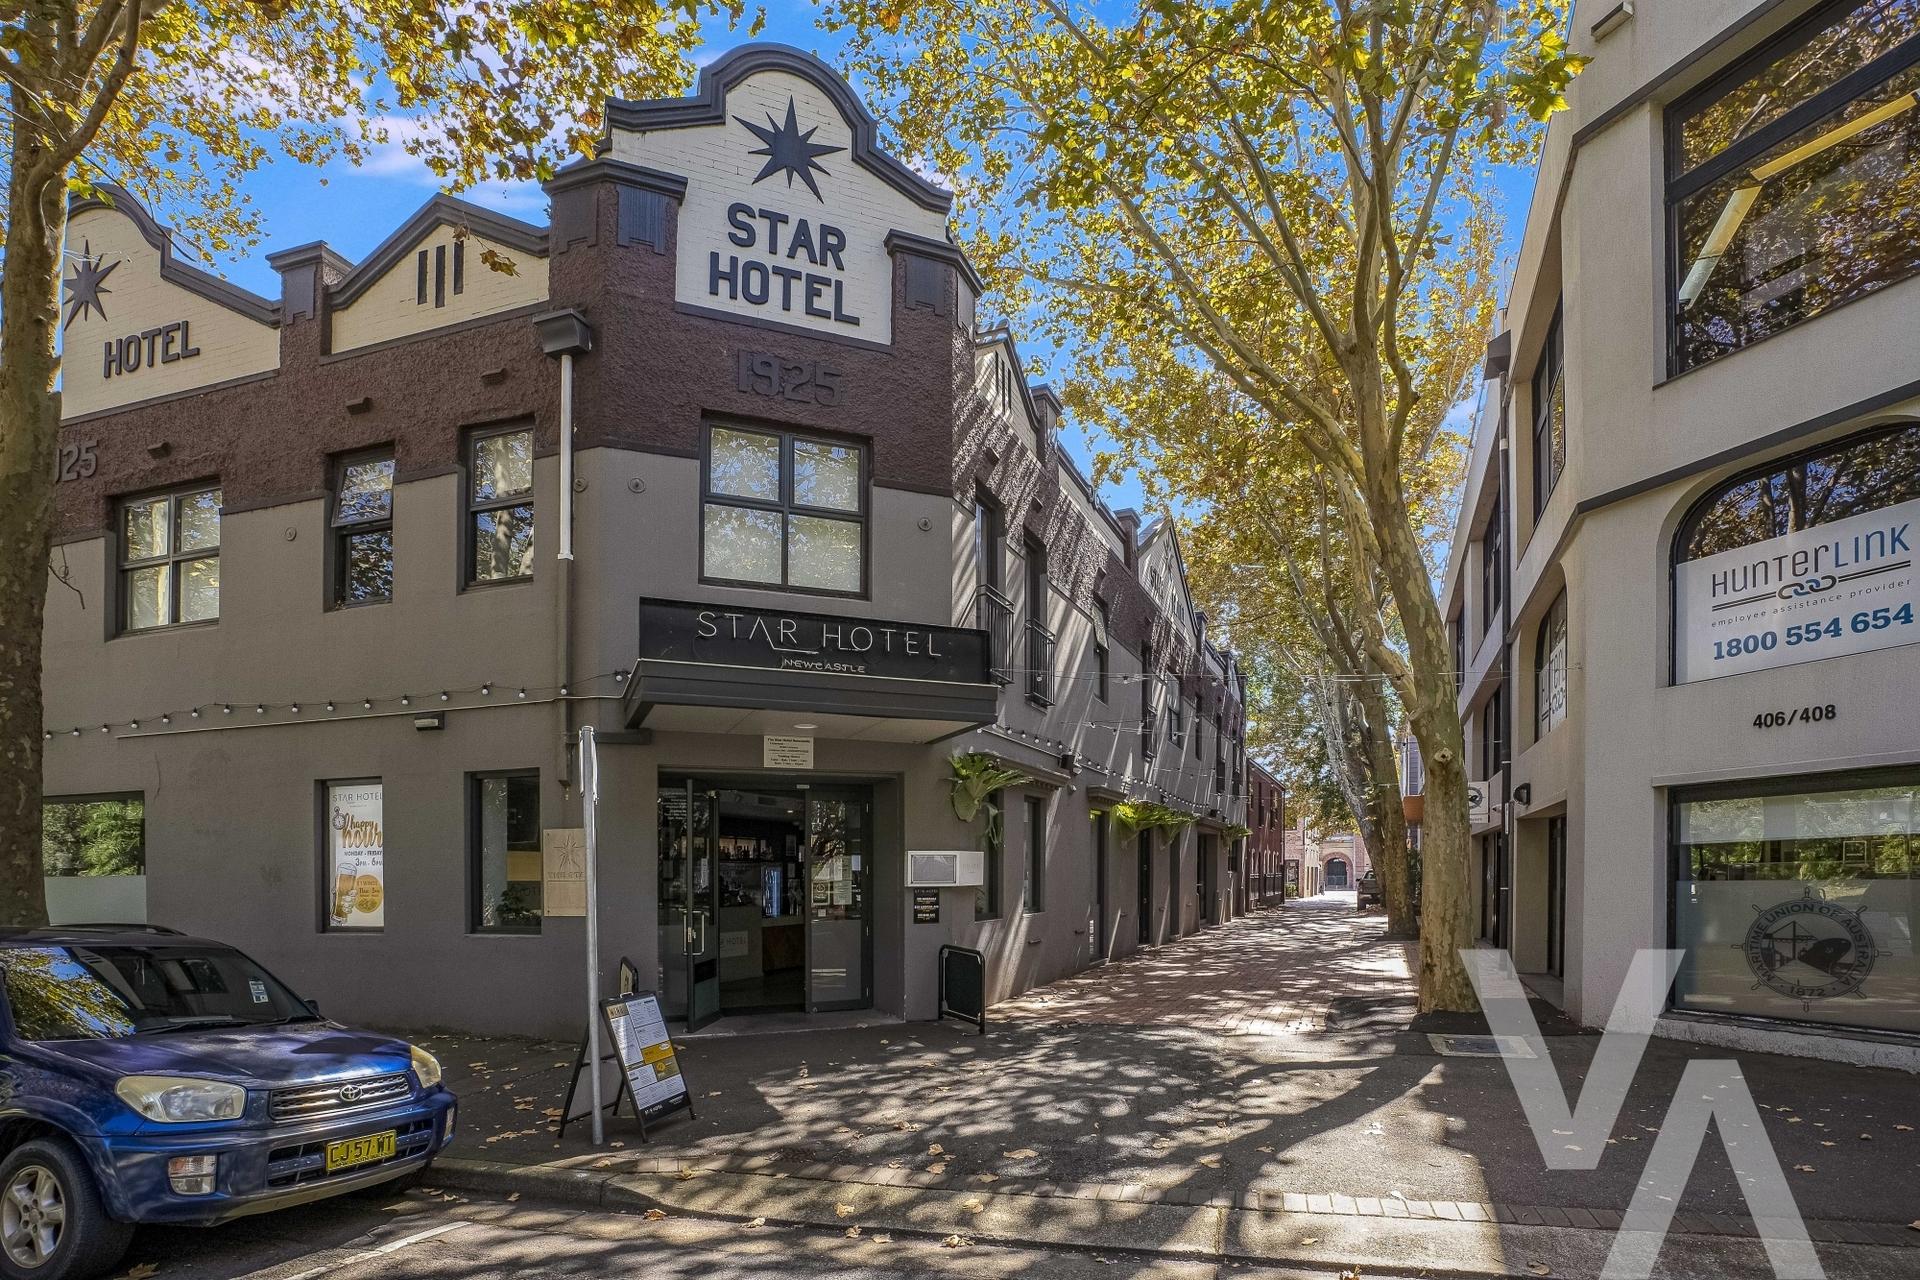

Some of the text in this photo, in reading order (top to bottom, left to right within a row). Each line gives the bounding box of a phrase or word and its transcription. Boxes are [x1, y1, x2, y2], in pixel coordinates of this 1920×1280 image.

[727, 203, 847, 271] STAR
[709, 251, 860, 326] HOTEL
[104, 320, 200, 379] HOTEL
[737, 349, 844, 407] 1925
[1711, 578, 1913, 628] employee assistance provider
[1713, 603, 1914, 660] 1800 554 654
[697, 611, 942, 657] STAR HOTEL
[784, 658, 866, 673] NEWCASTLE
[1752, 704, 1836, 729] 406/408
[1751, 903, 1871, 986] MARITIME UNION OF AUSTRALIA
[1789, 988, 1826, 998] 1872
